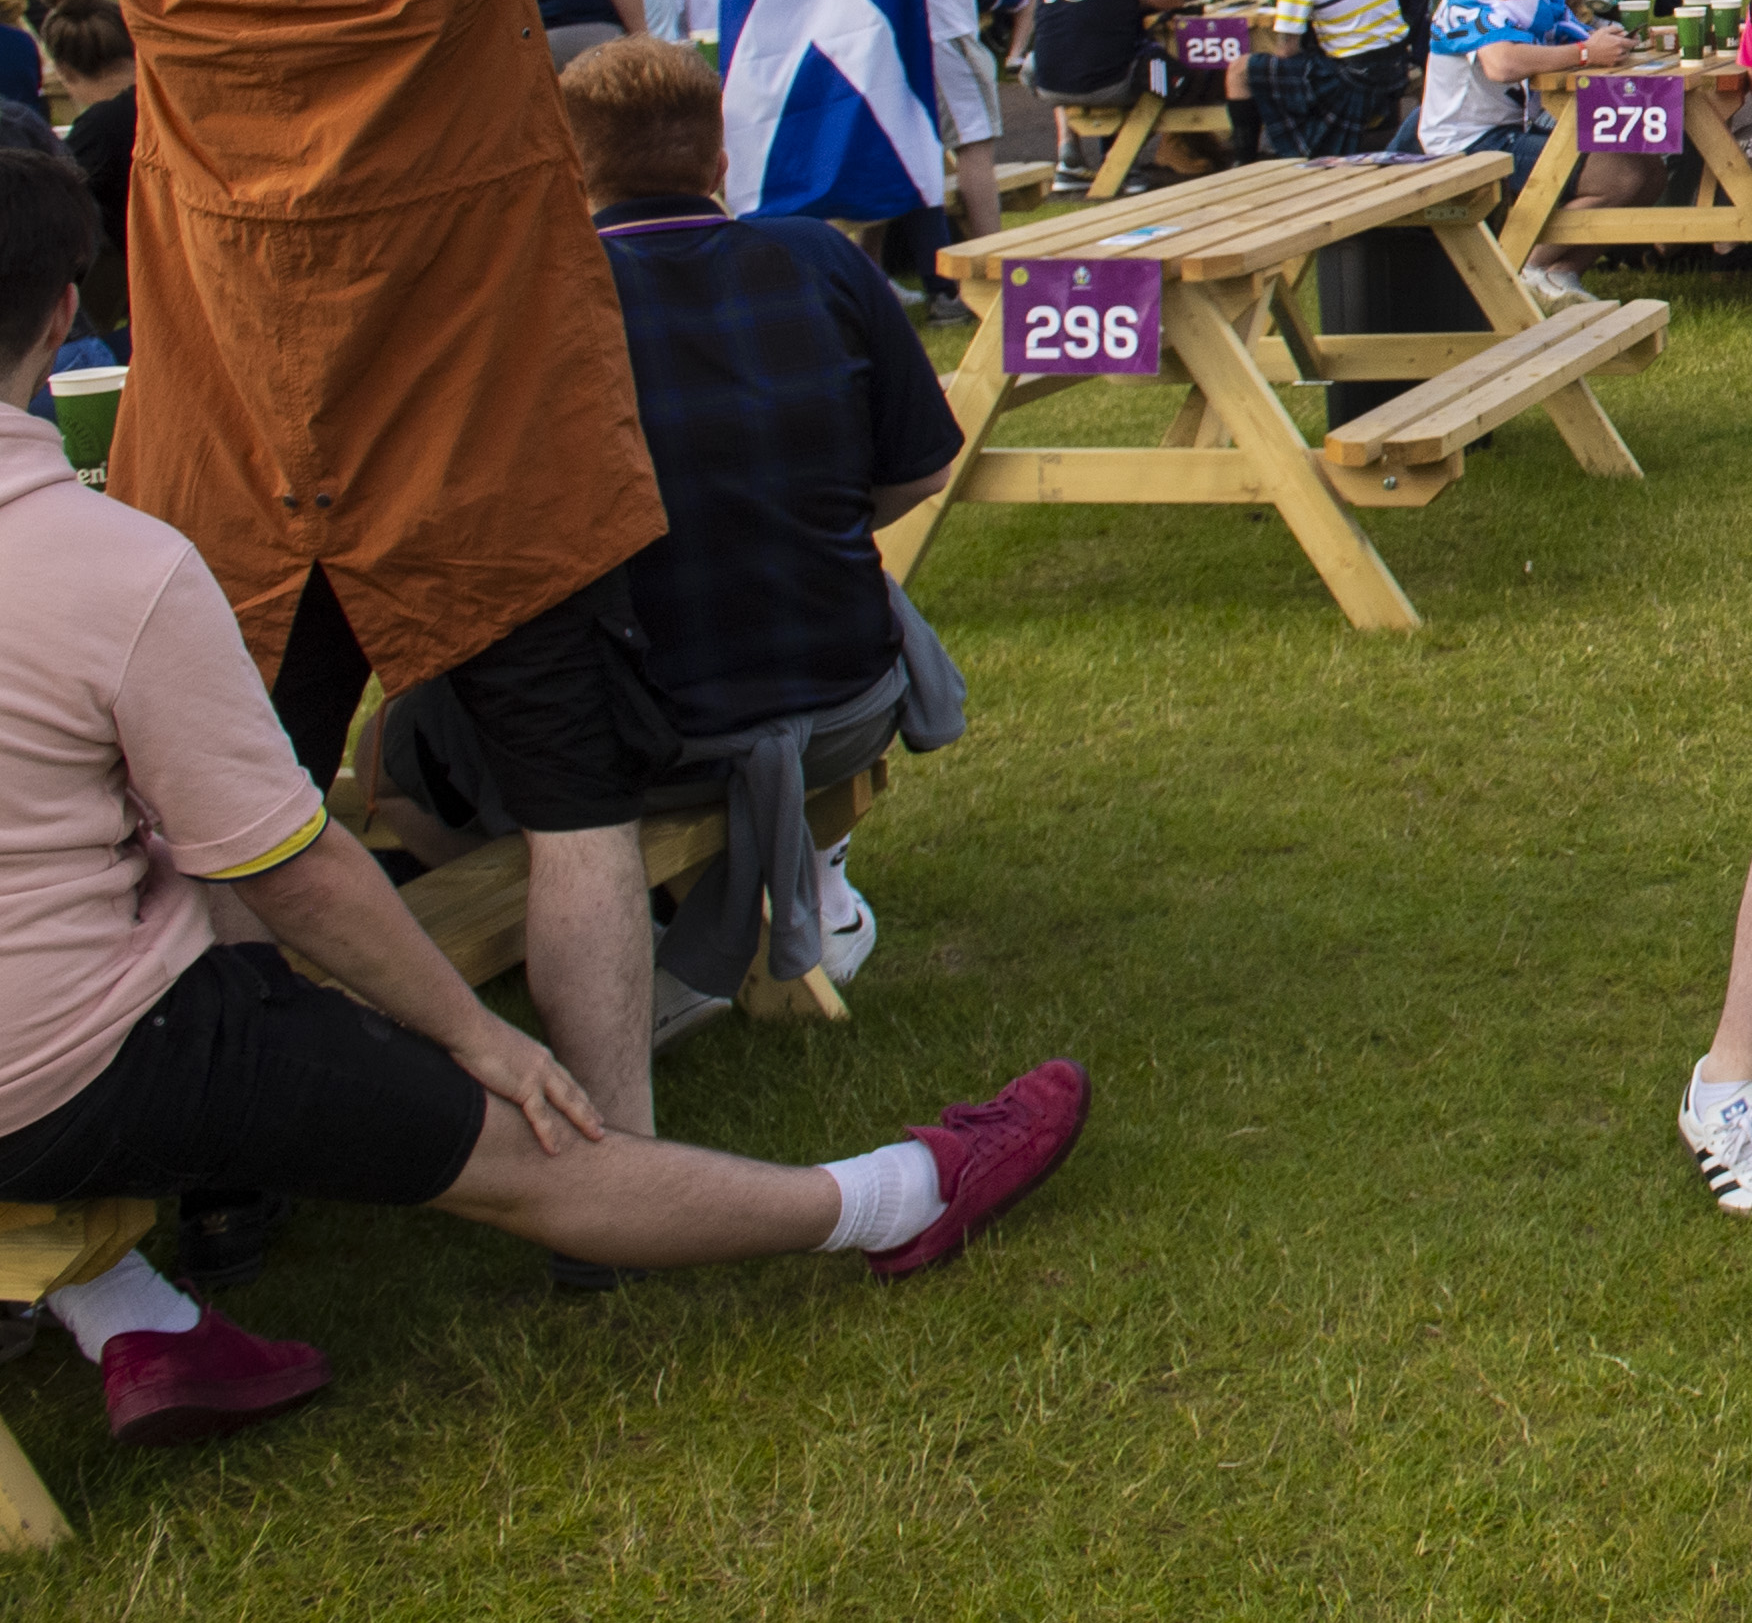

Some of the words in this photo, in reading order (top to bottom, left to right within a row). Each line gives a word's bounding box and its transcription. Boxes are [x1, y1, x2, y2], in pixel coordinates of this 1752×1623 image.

[1185, 37, 1241, 63] 258
[1592, 106, 1668, 143] 278
[1024, 305, 1139, 360] 296
